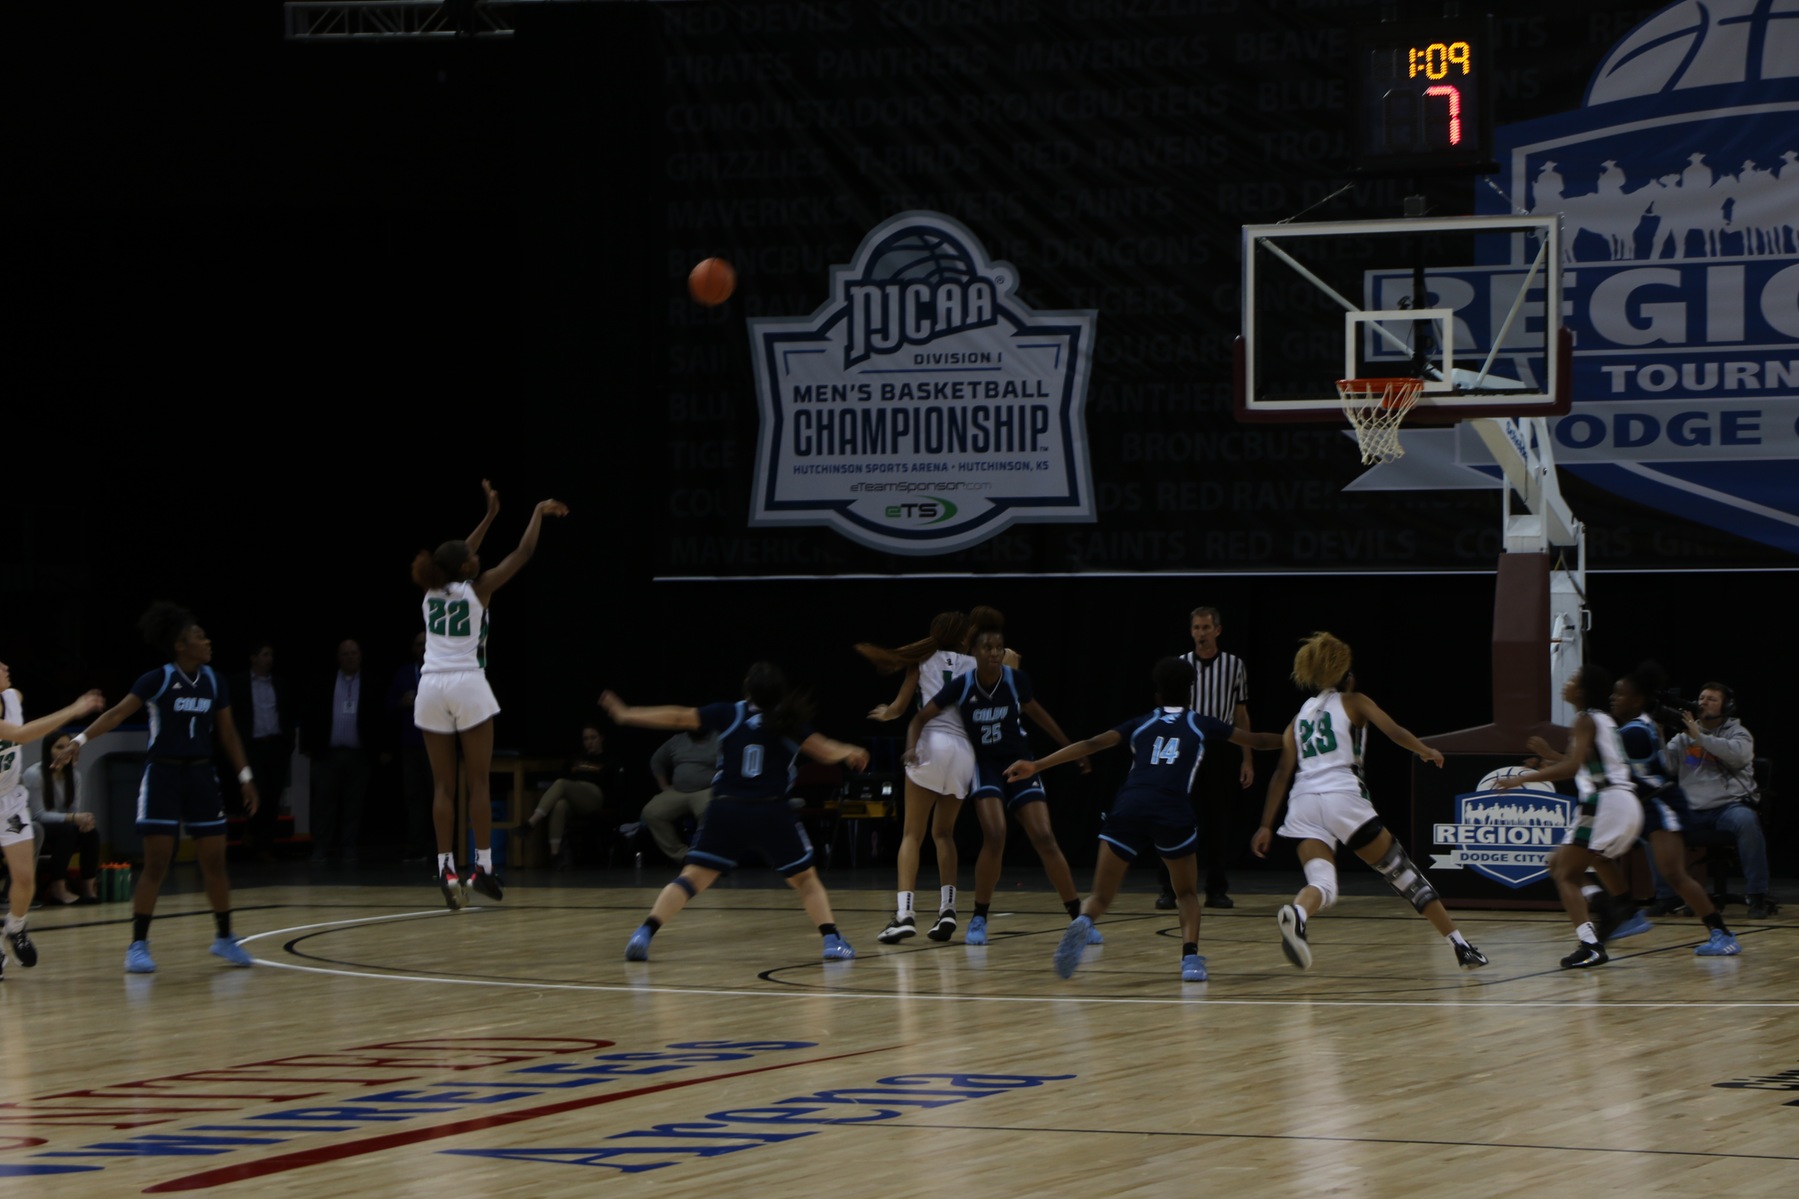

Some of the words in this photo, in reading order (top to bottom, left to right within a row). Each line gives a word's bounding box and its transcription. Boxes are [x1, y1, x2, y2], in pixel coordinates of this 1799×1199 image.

[737, 2, 854, 34] DEVILS
[879, 0, 1040, 28] COUGARS
[664, 52, 793, 85] PIRATES
[816, 45, 988, 80] PANTHERS
[1012, 35, 1210, 72] MAVERICKS
[1235, 28, 1347, 64] BEAVE
[1408, 40, 1473, 81] 1:09
[664, 95, 946, 133] CONQUISTADORS
[961, 84, 1230, 124] BRONCBUSTERS
[1257, 78, 1345, 113] BLUE
[1422, 84, 1463, 147] 7
[665, 148, 828, 182] GRIZZLIES
[1012, 140, 1079, 171] RED
[1095, 135, 1232, 168] RAVENS
[1258, 130, 1350, 162] TROJ
[667, 194, 856, 230] MAVERICKS
[1051, 187, 1176, 220] SAINTS
[1217, 182, 1286, 213] RED
[1041, 235, 1211, 268] DRAGONS
[1070, 285, 1187, 316] TIGERS
[845, 278, 996, 370] NJCAA
[914, 352, 991, 365] DIVISION
[793, 383, 872, 403] MEN'S
[881, 379, 1049, 401] BASKETBALL
[794, 404, 1049, 457] CHAMPIONSHIP
[1120, 428, 1346, 464] BRONCBUST
[1540, 409, 1763, 449] ODGE
[793, 463, 863, 475] HUTCHINSON
[865, 462, 909, 474] SPORTS
[910, 461, 949, 473] ARENA
[1036, 460, 1050, 471] KS
[885, 503, 938, 518] eTS
[1155, 480, 1225, 512] RED
[1064, 531, 1186, 562] SAINTS
[1205, 531, 1274, 562] RED
[1292, 528, 1417, 560] DEVILS
[428, 598, 471, 636] 22
[189, 716, 197, 739] 1
[981, 722, 1003, 745] 25
[1300, 710, 1338, 759] 23
[1150, 735, 1181, 765] 14
[1437, 826, 1553, 845] REGION
[1460, 853, 1509, 862] DODGE
[28, 1040, 820, 1159] WIRELESS
[435, 1073, 1078, 1173] Arena
